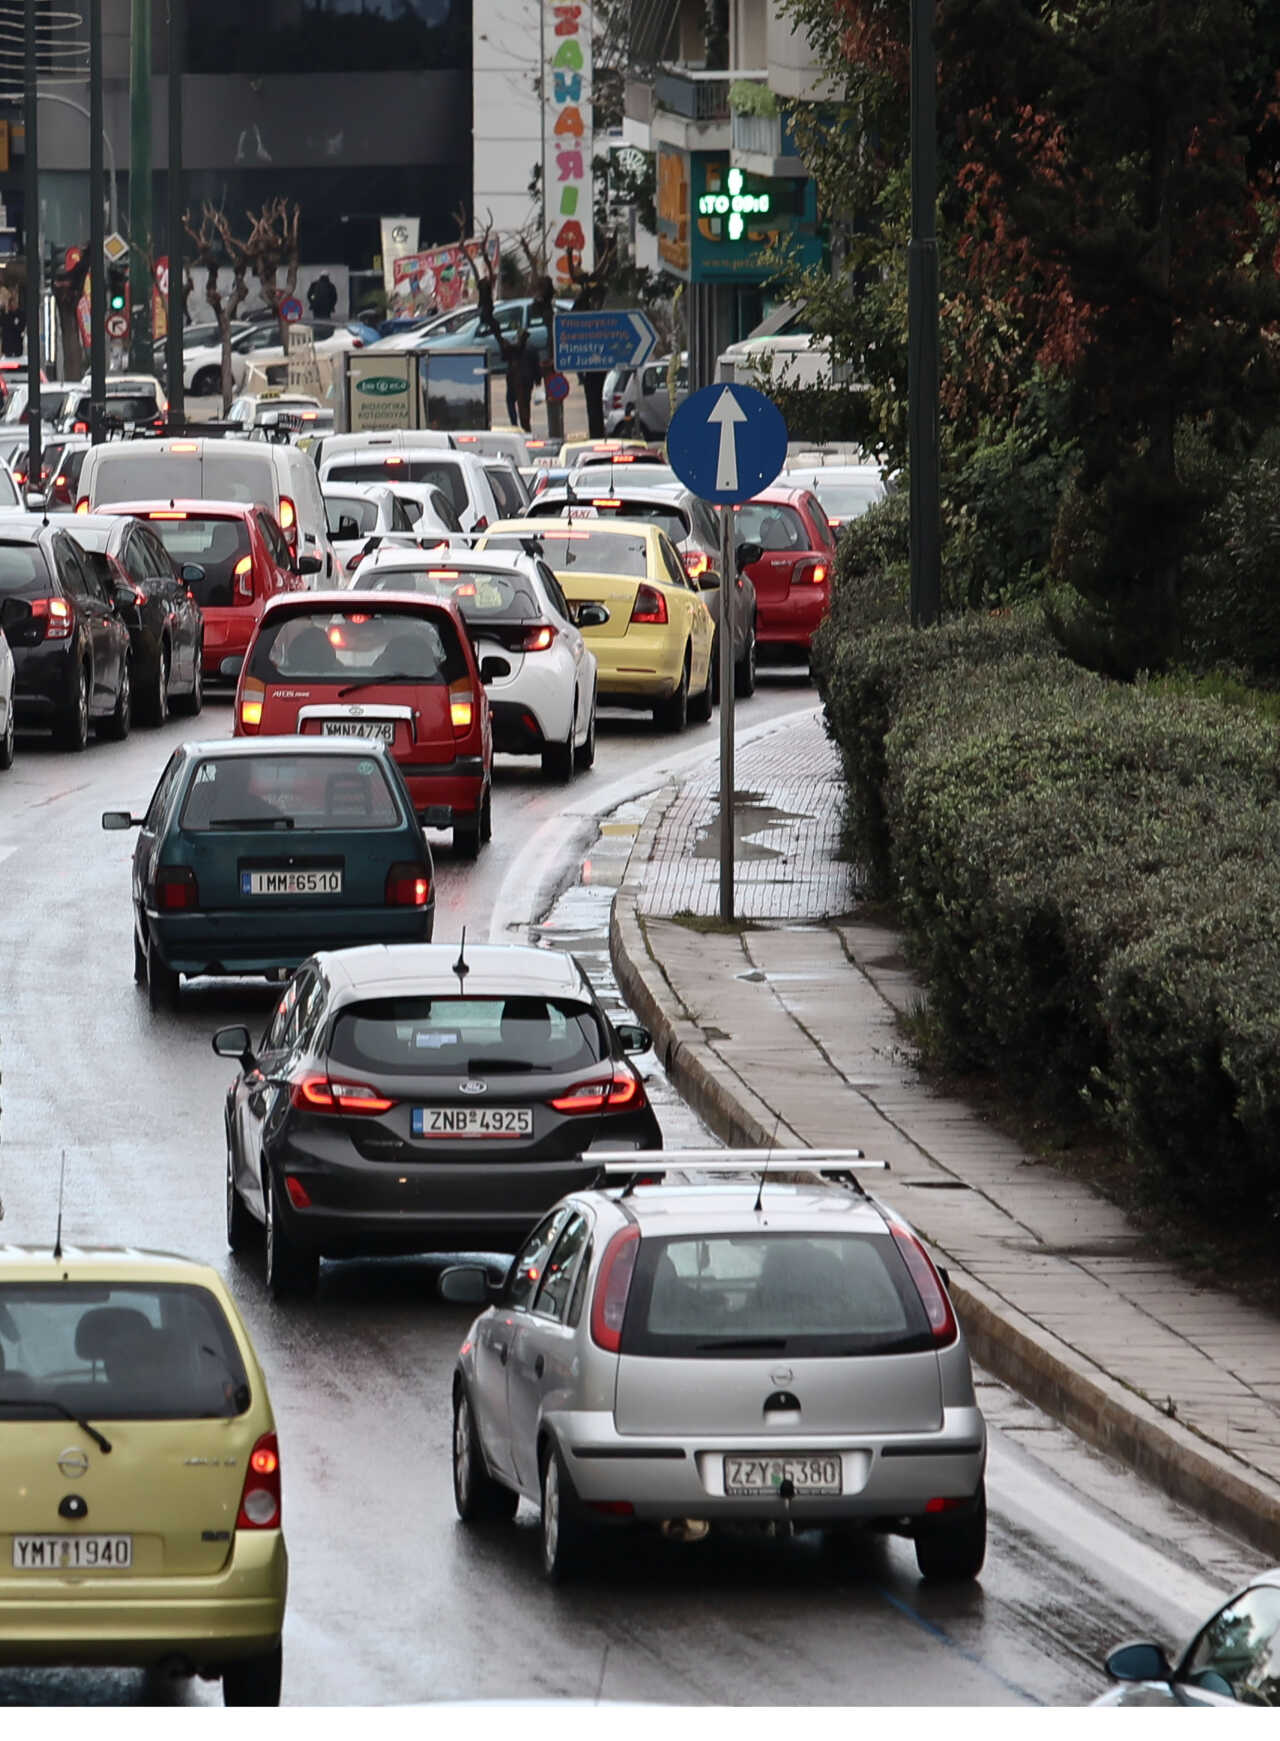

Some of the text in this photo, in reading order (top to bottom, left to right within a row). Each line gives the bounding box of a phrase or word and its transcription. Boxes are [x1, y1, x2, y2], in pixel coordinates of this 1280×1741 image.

[559, 343, 605, 353] Ministry
[296, 873, 339, 891] 6510
[430, 1111, 529, 1131] ZNB 4925
[730, 1461, 769, 1484] ZZY
[17, 1539, 128, 1566] YMT 1940
